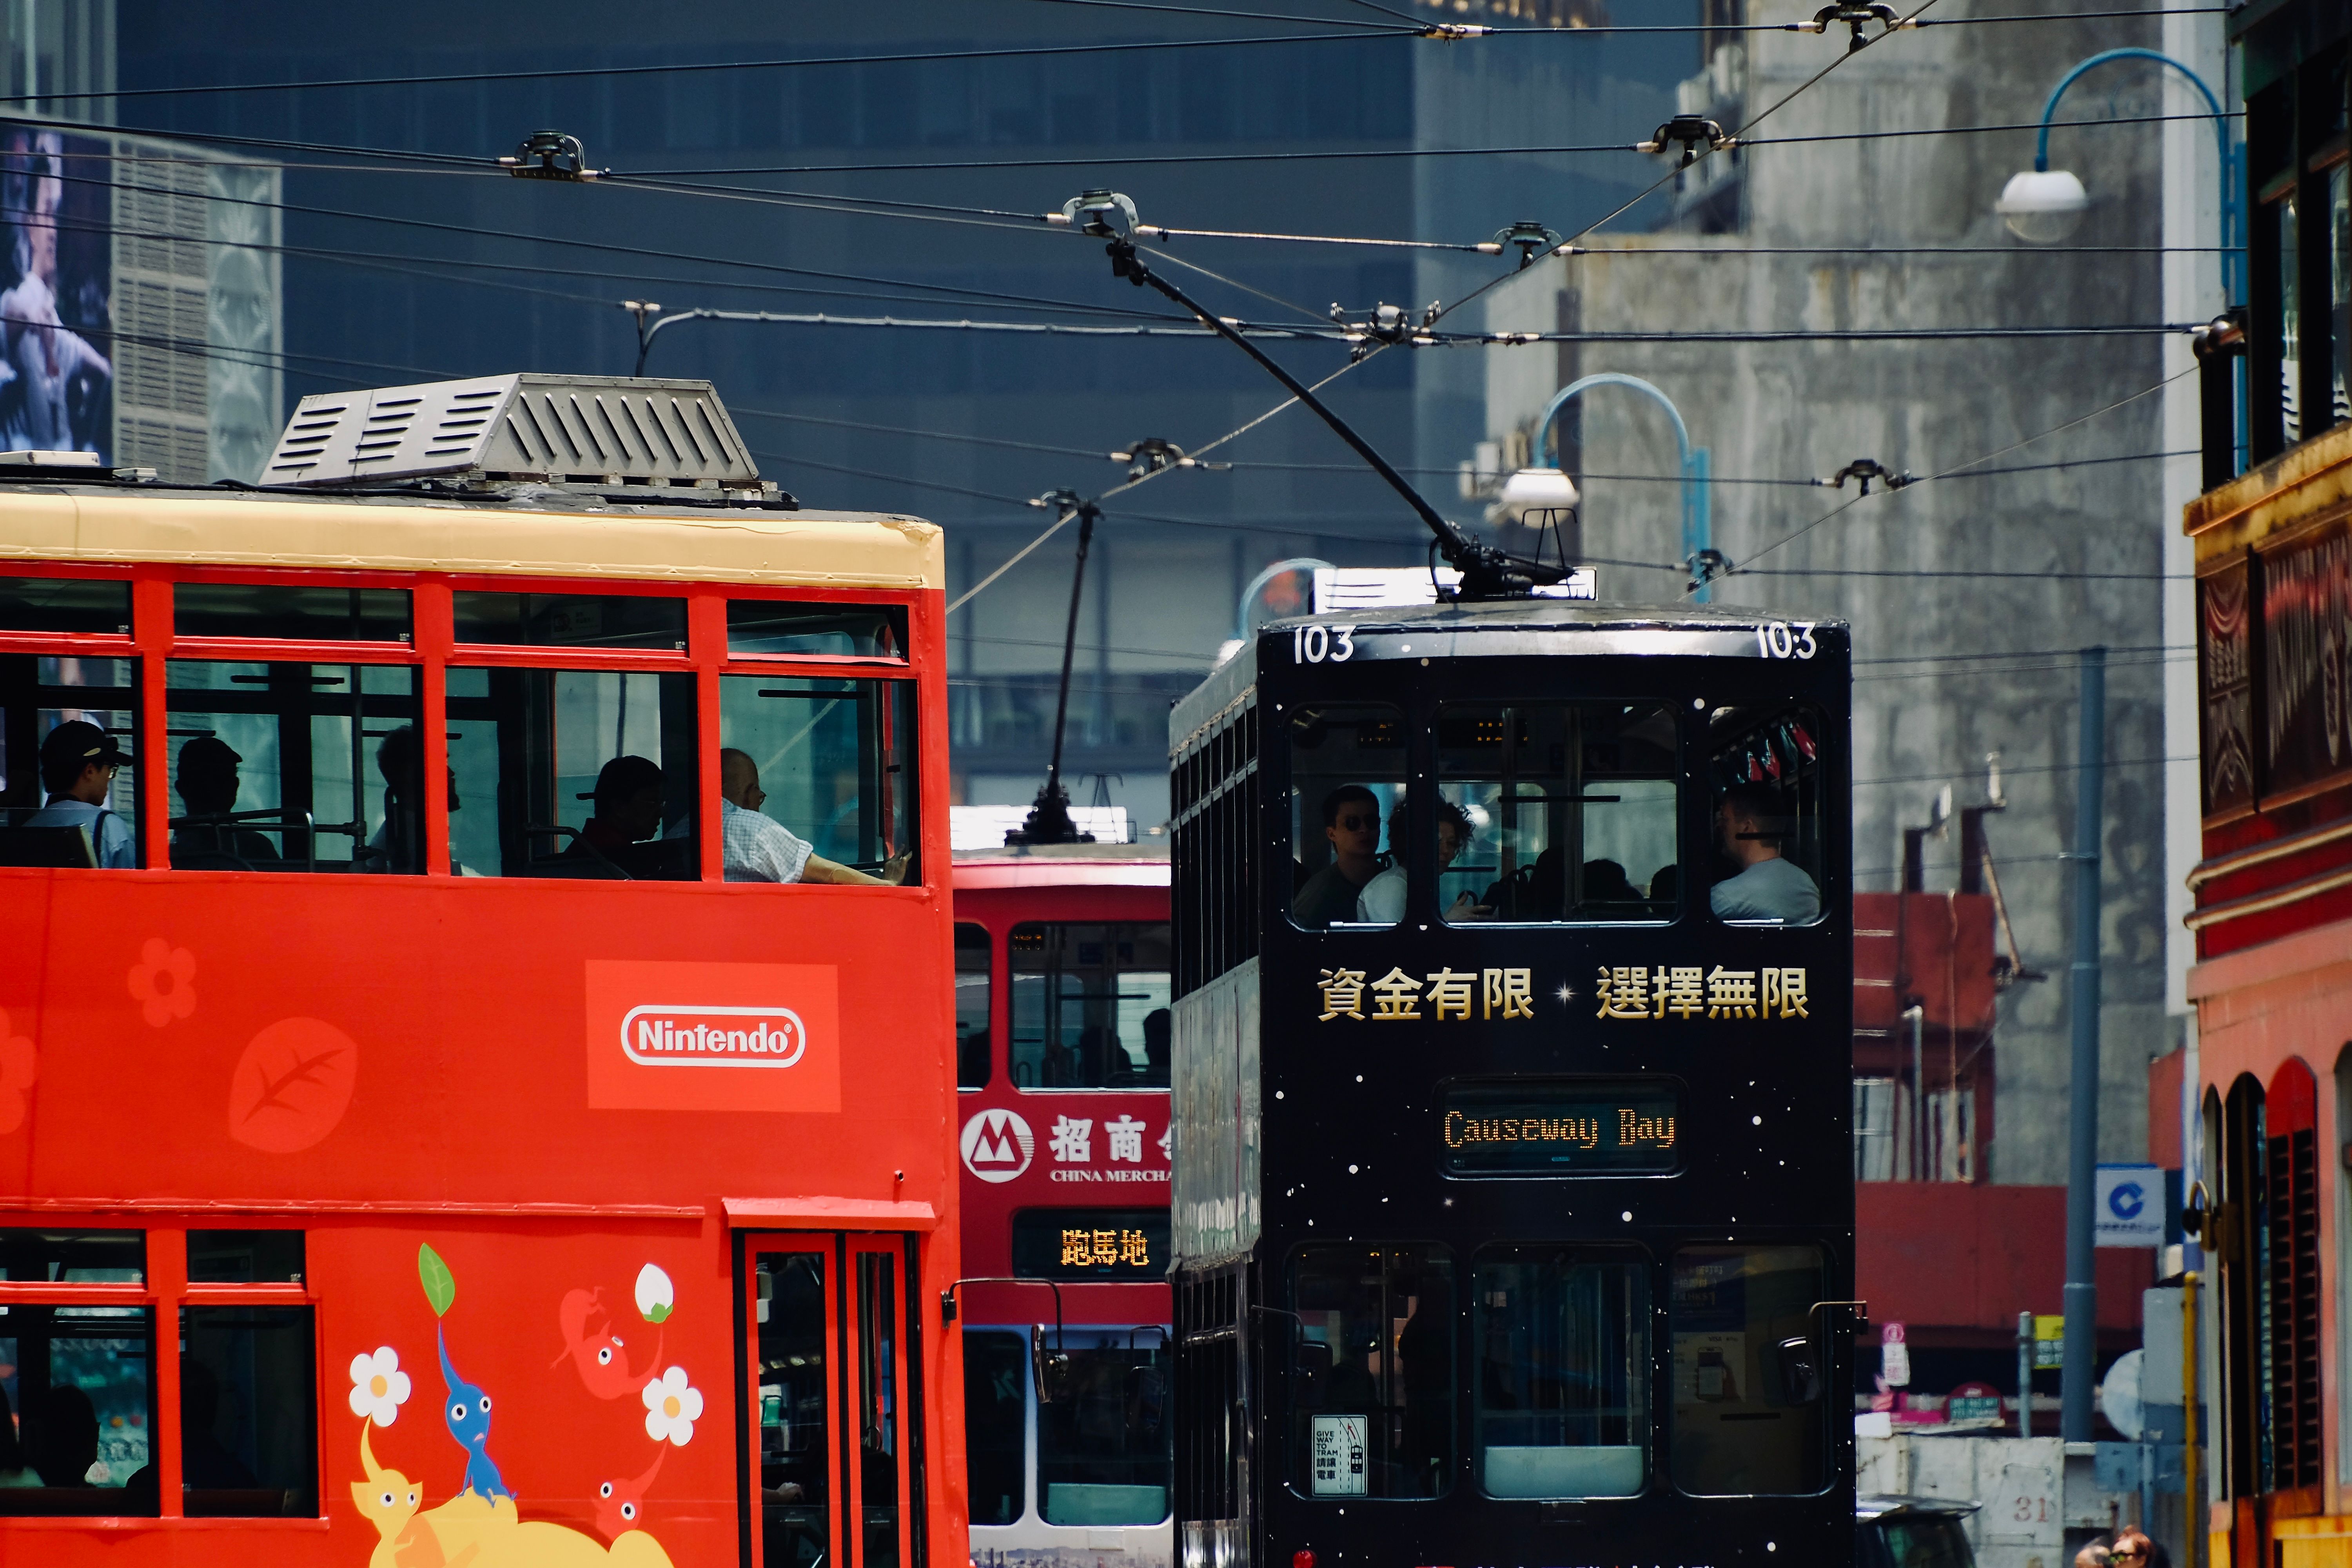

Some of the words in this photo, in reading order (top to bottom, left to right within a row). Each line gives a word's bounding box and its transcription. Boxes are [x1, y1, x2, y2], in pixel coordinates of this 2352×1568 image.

[1294, 625, 1356, 664] 103
[1757, 622, 1817, 659] 103
[1318, 967, 1534, 1022] 資金有限
[1596, 965, 1809, 1020] 選擇無限
[1445, 1111, 1598, 1149] Causeway
[1618, 1109, 1675, 1149] Bay
[1050, 1171, 1103, 1182] CHINA
[1061, 1229, 1149, 1266] 跑馬地
[1316, 1470, 1337, 1480] 電車
[2013, 1495, 2049, 1523] 31
